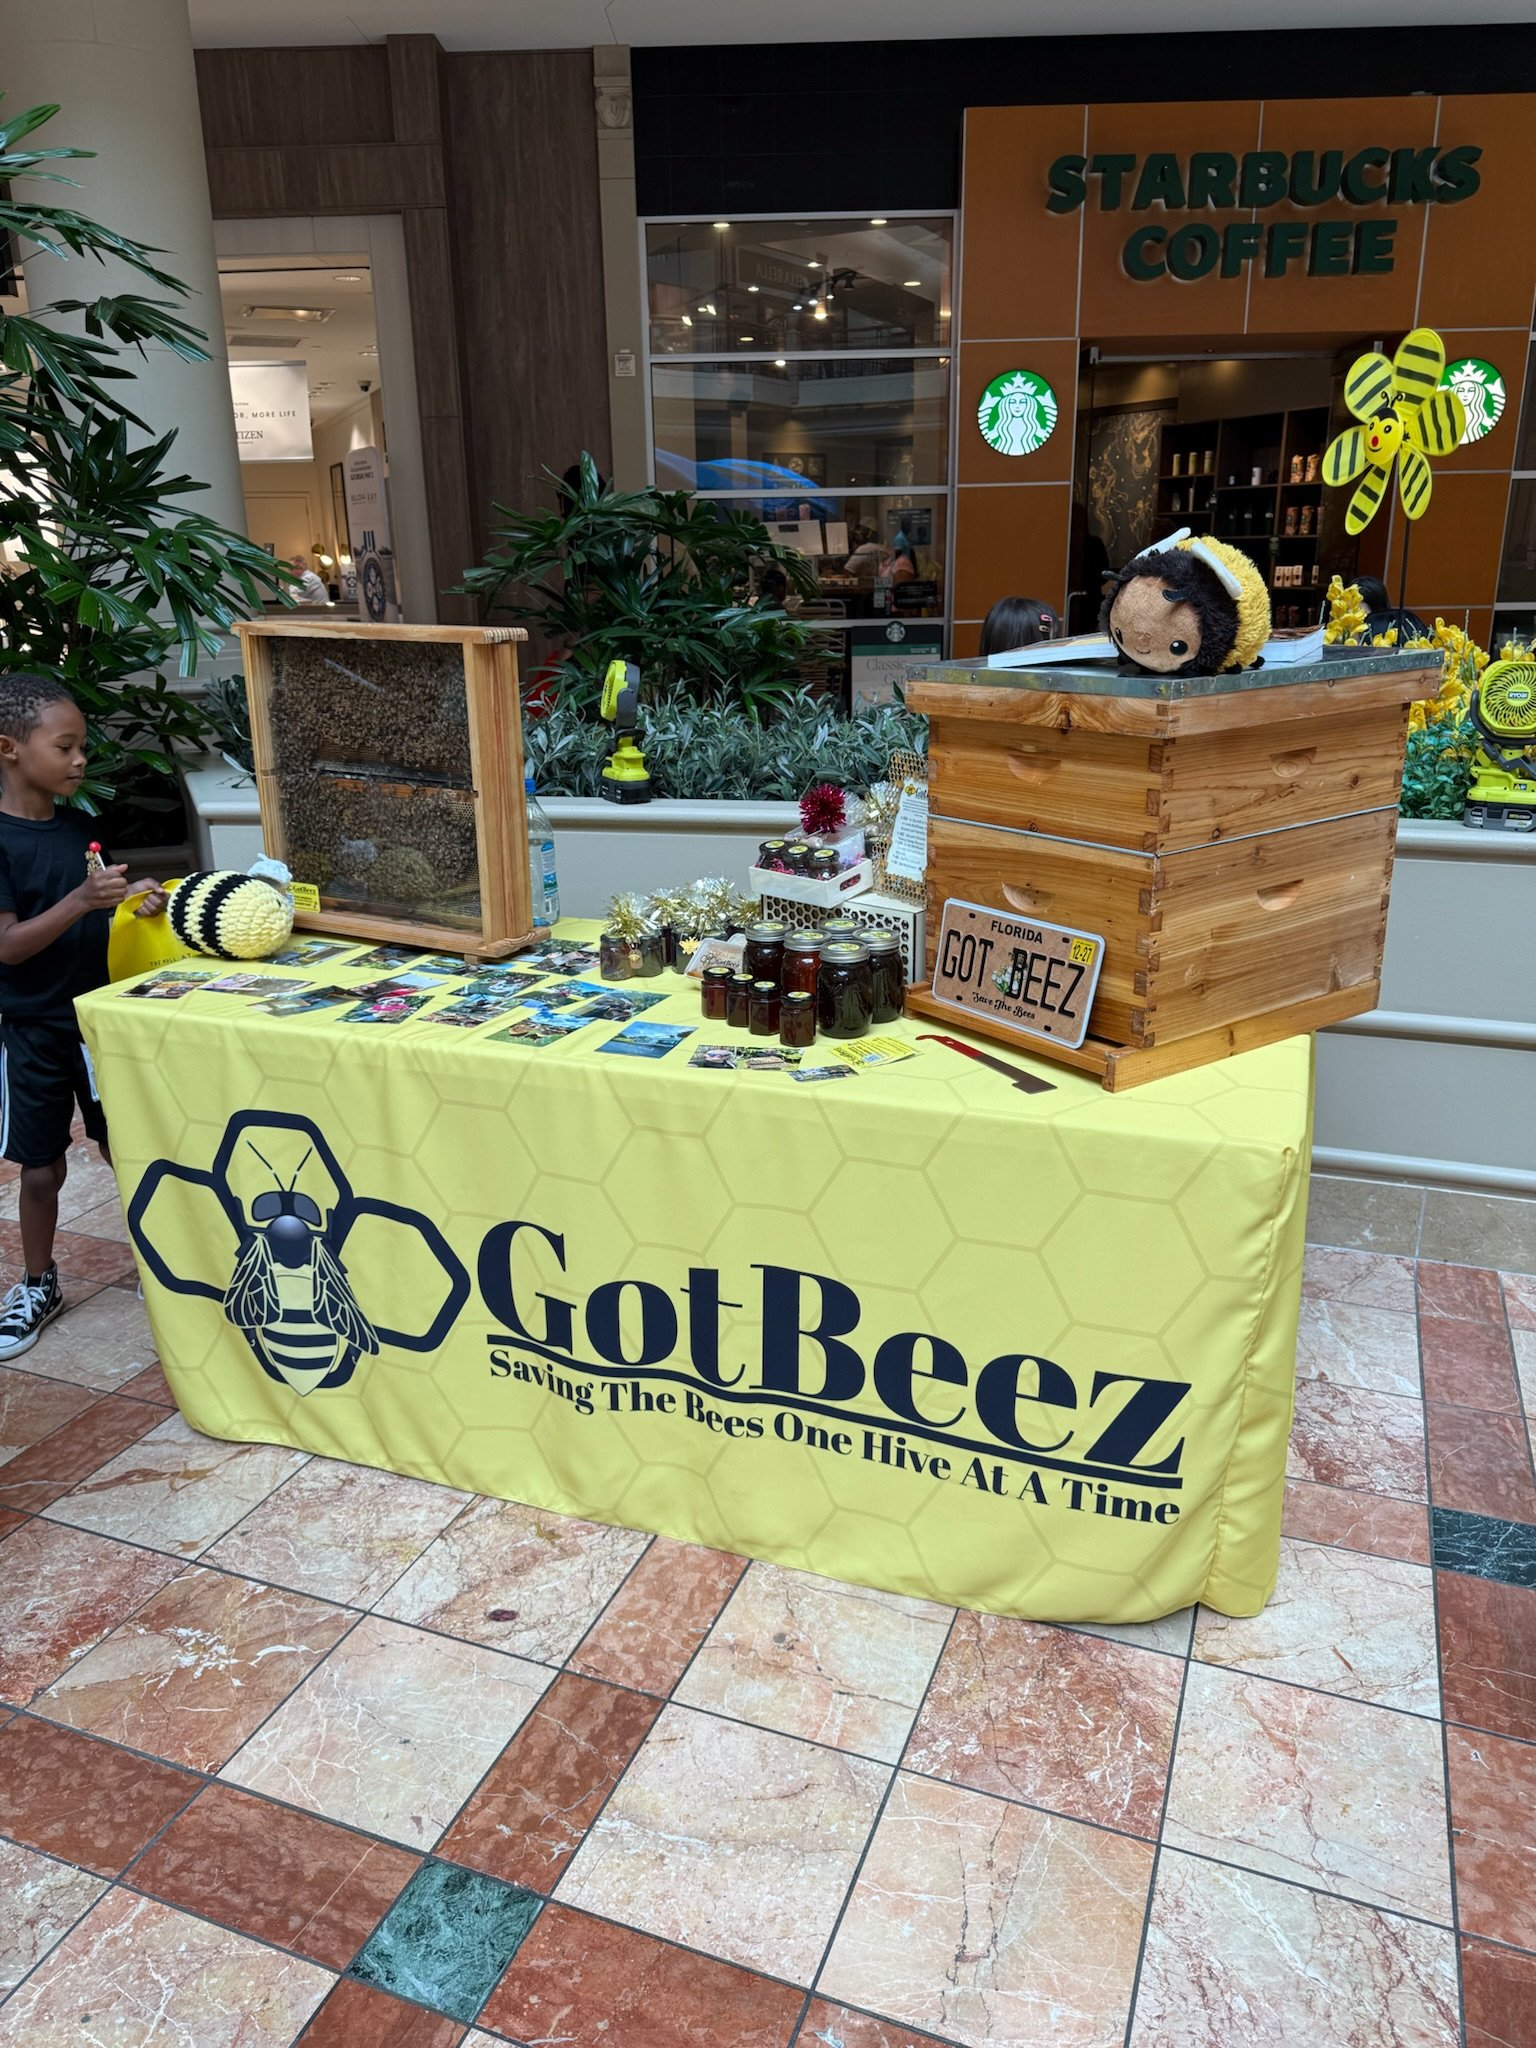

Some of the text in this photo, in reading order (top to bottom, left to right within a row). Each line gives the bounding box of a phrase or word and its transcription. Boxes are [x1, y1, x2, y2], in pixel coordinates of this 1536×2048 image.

[1046, 145, 1484, 214] STARBUCKS
[1121, 219, 1398, 281] COFFEE
[990, 920, 1043, 944] FLORIDA
[941, 929, 1086, 1019] GOT BEEZ
[972, 992, 1035, 1020] Save The Bees
[477, 1220, 1193, 1475] GotBeez
[490, 1349, 1181, 1526] Saving The Bees One Hive At A Time
